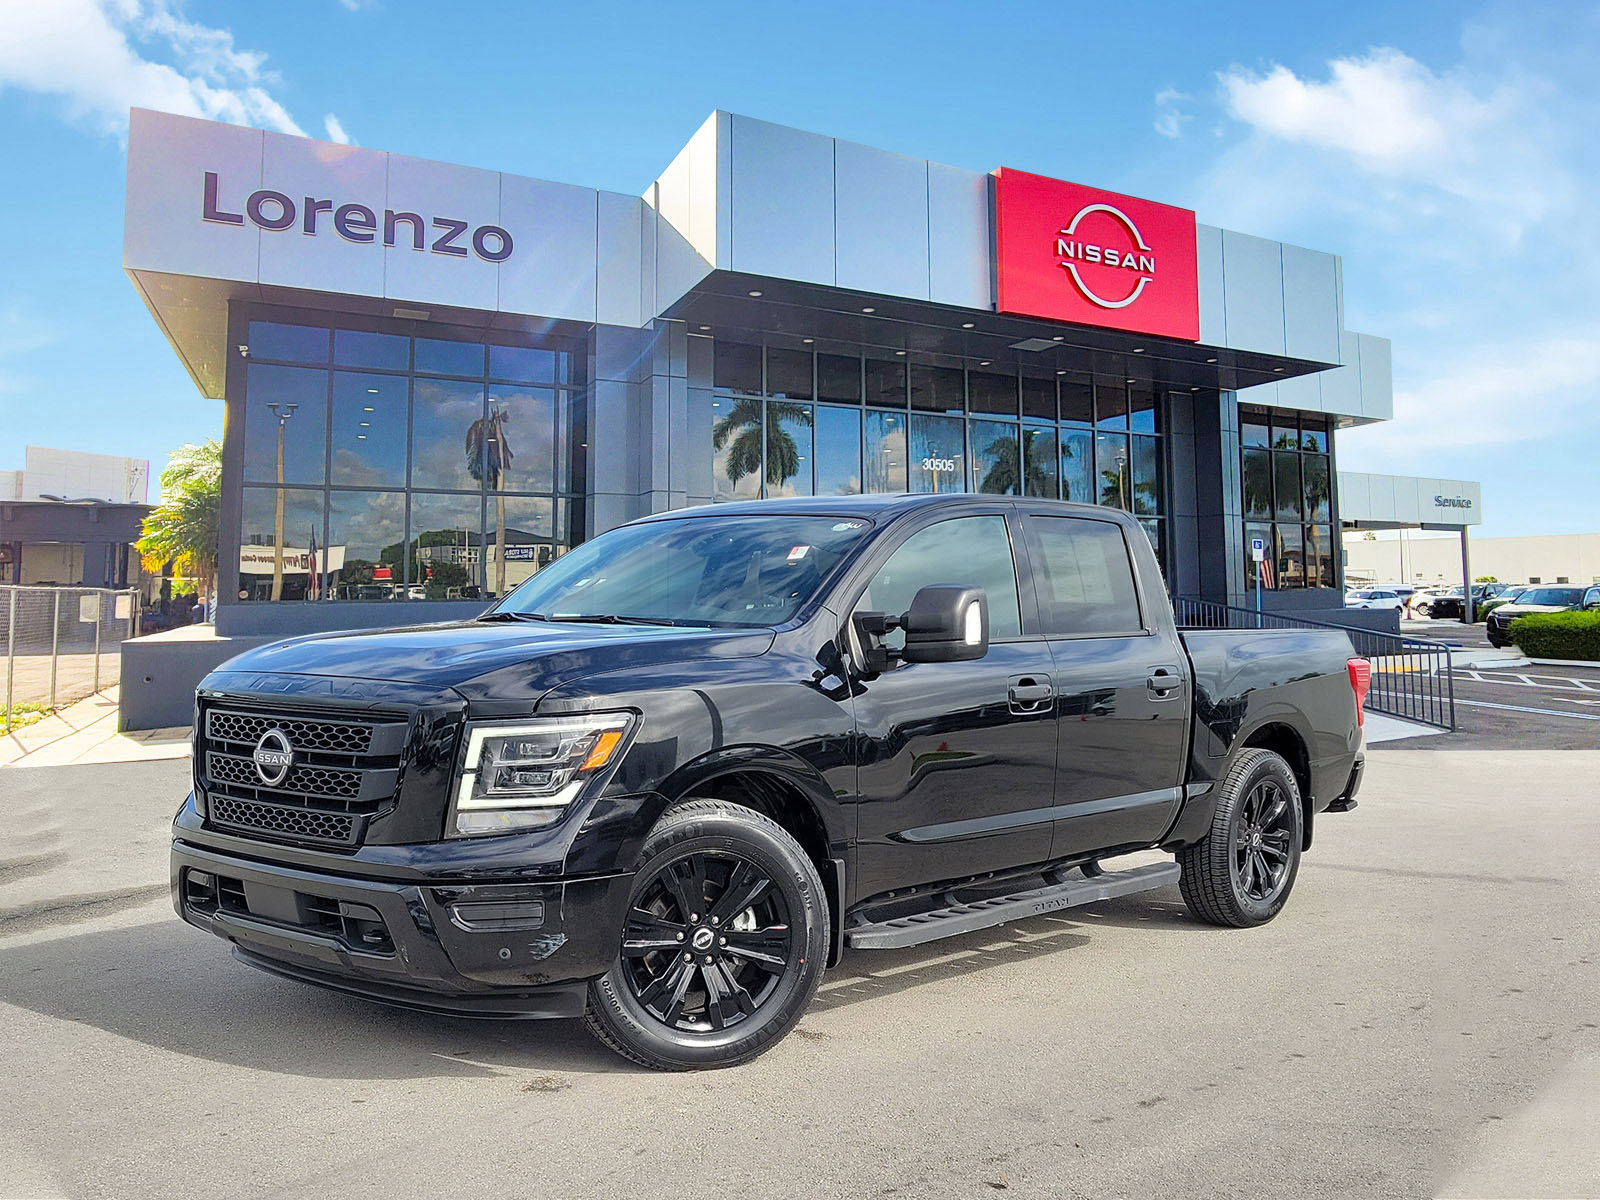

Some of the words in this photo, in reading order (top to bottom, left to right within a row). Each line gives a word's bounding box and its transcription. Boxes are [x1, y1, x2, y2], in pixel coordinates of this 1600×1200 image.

[202, 171, 514, 262] Lorenzo
[1057, 238, 1155, 273] NISSAN
[922, 457, 954, 472] 30505
[1434, 495, 1472, 508] Service
[254, 753, 290, 765] ISSAN
[1032, 897, 1069, 912] TITAN
